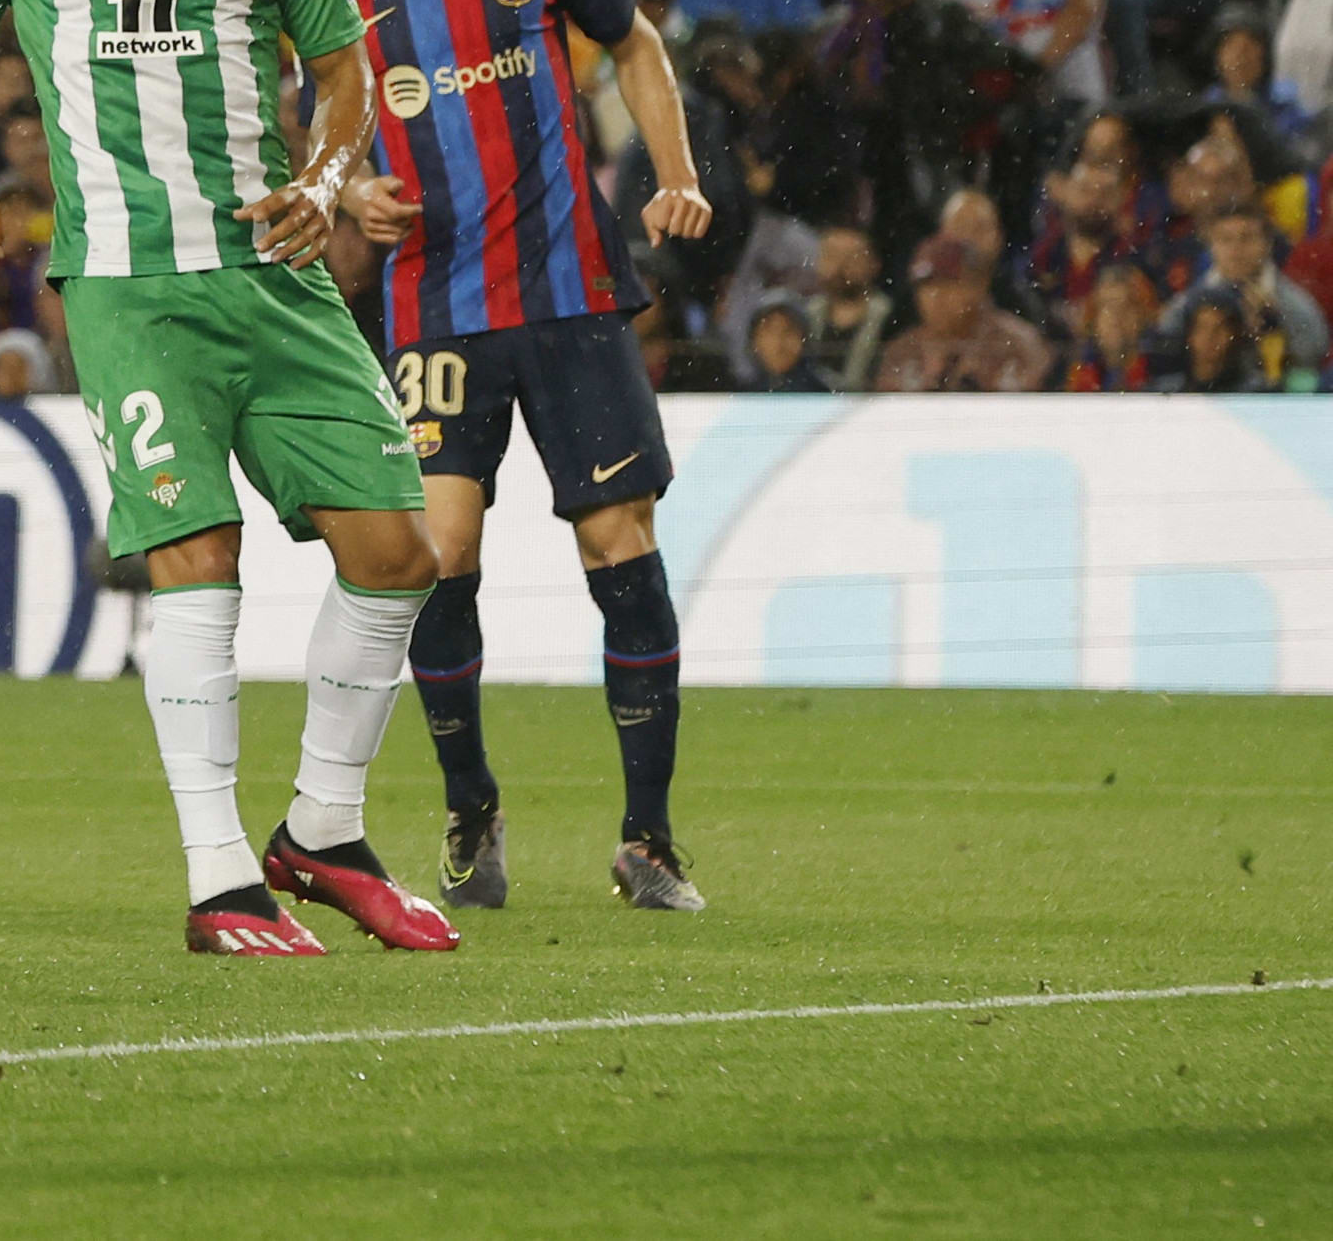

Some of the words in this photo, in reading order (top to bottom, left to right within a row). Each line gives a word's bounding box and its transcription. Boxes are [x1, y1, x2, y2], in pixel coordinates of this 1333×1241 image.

[100, 35, 197, 55] network
[434, 46, 537, 96] Spotify
[394, 350, 468, 421] 30
[120, 389, 176, 471] 2
